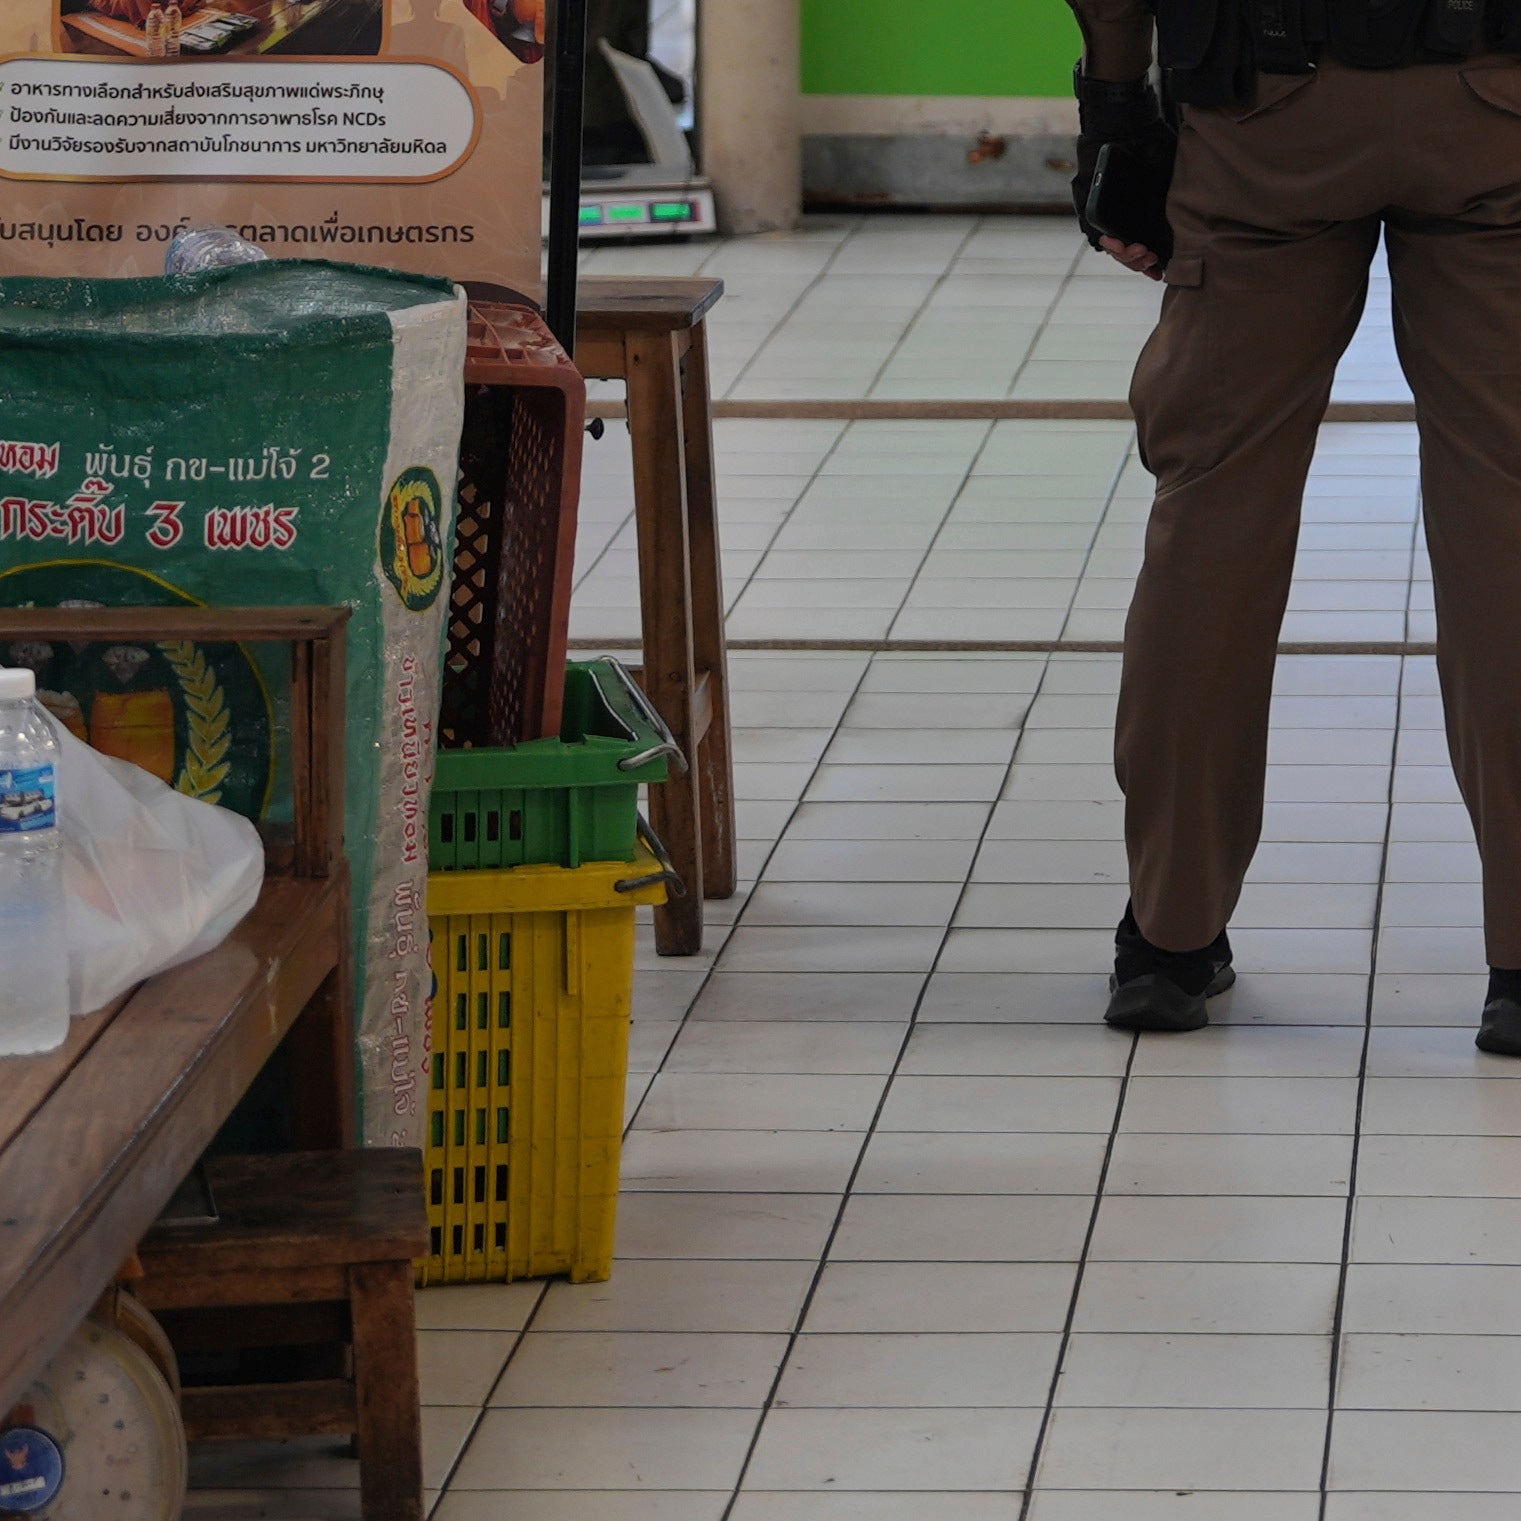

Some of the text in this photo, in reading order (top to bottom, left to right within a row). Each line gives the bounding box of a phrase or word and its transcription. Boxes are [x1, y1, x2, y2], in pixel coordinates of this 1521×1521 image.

[9, 80, 385, 104] อาหารทางเลือกสำหรับส่งเสริมสุขภาพแด่พระภิกษุ
[8, 105, 387, 129] ป้องกันและลดความเสี่ยงจากการอาพาธโรค NCDs
[8, 133, 448, 156] มีงานวิจัยรองรับจากสถาบันโภชนาการ มหาวิทยาลัยมหิดล
[136, 210, 475, 244] องค์ตลาดเพื่อเกษตรกร
[84, 444, 155, 488] พันธุ์
[165, 444, 299, 482] กข-แม่โจ้
[310, 454, 331, 480] 2
[144, 500, 186, 549] 3
[204, 503, 300, 551] เพชร
